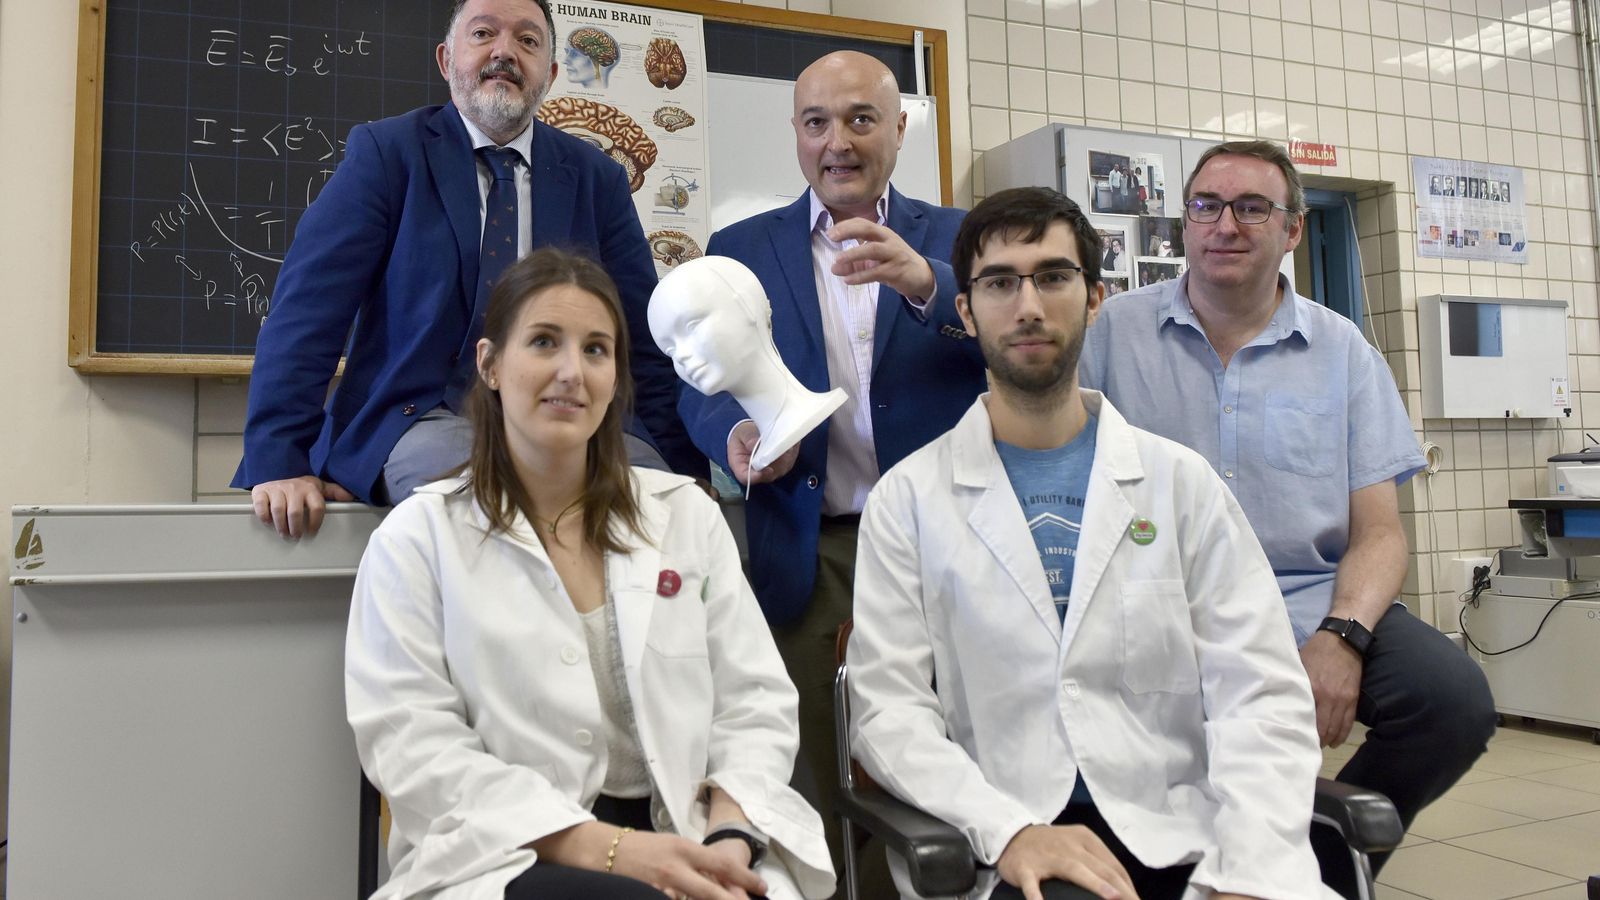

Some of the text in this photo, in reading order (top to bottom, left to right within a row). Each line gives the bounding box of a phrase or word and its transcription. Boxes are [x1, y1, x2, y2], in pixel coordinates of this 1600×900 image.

[557, 4, 607, 20] HUMAN
[611, 10, 651, 26] BRAIN
[1291, 147, 1335, 161] SIN SALIDA
[1029, 495, 1063, 505] UTILITY
[1046, 570, 1065, 584] ST.
